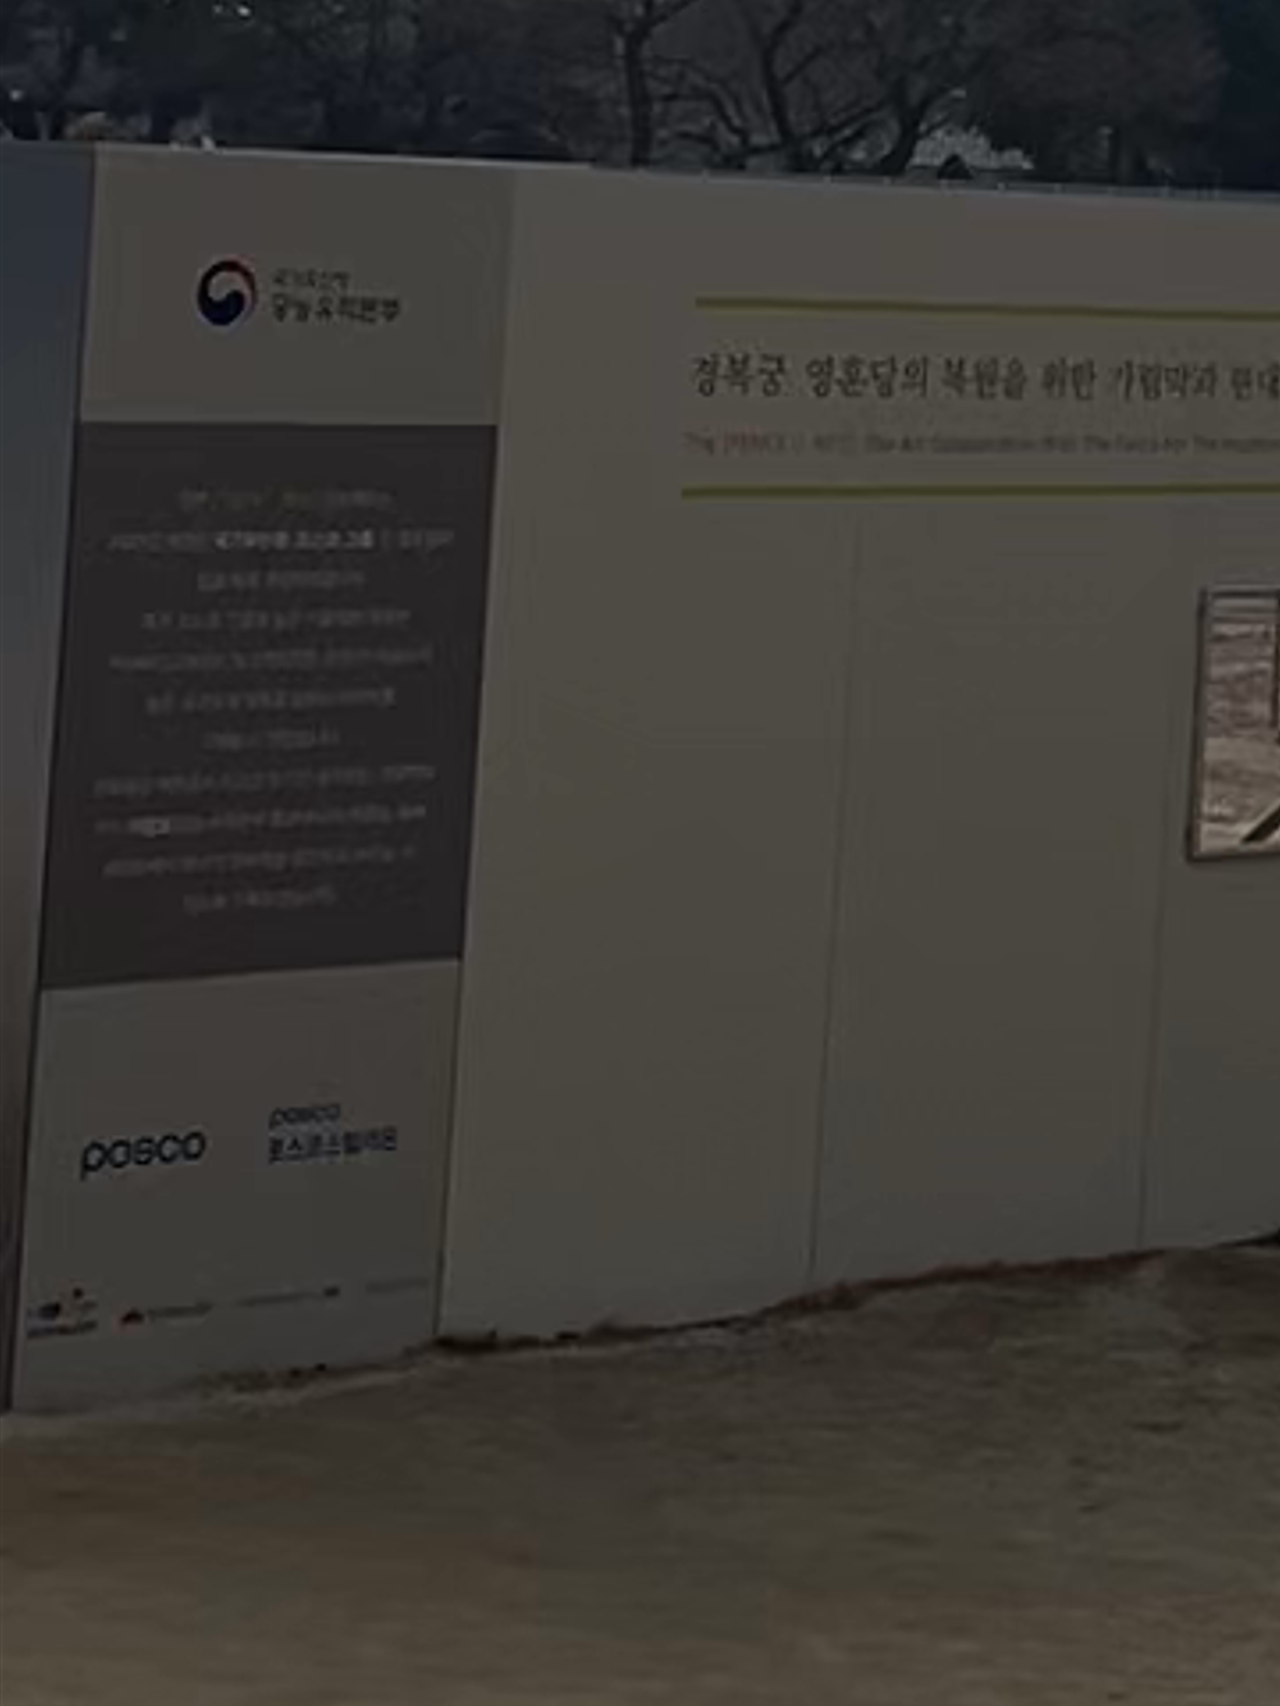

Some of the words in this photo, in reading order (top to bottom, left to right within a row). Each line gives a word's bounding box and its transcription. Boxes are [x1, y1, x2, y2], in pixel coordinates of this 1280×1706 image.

[694, 354, 787, 397] 경복궁
[806, 354, 930, 398] 영훈당의
[943, 356, 1028, 400] 복원을
[1041, 356, 1098, 400] 위한
[1112, 358, 1218, 402] 가림막과
[269, 1103, 341, 1129] posco
[79, 1131, 207, 1181] posco
